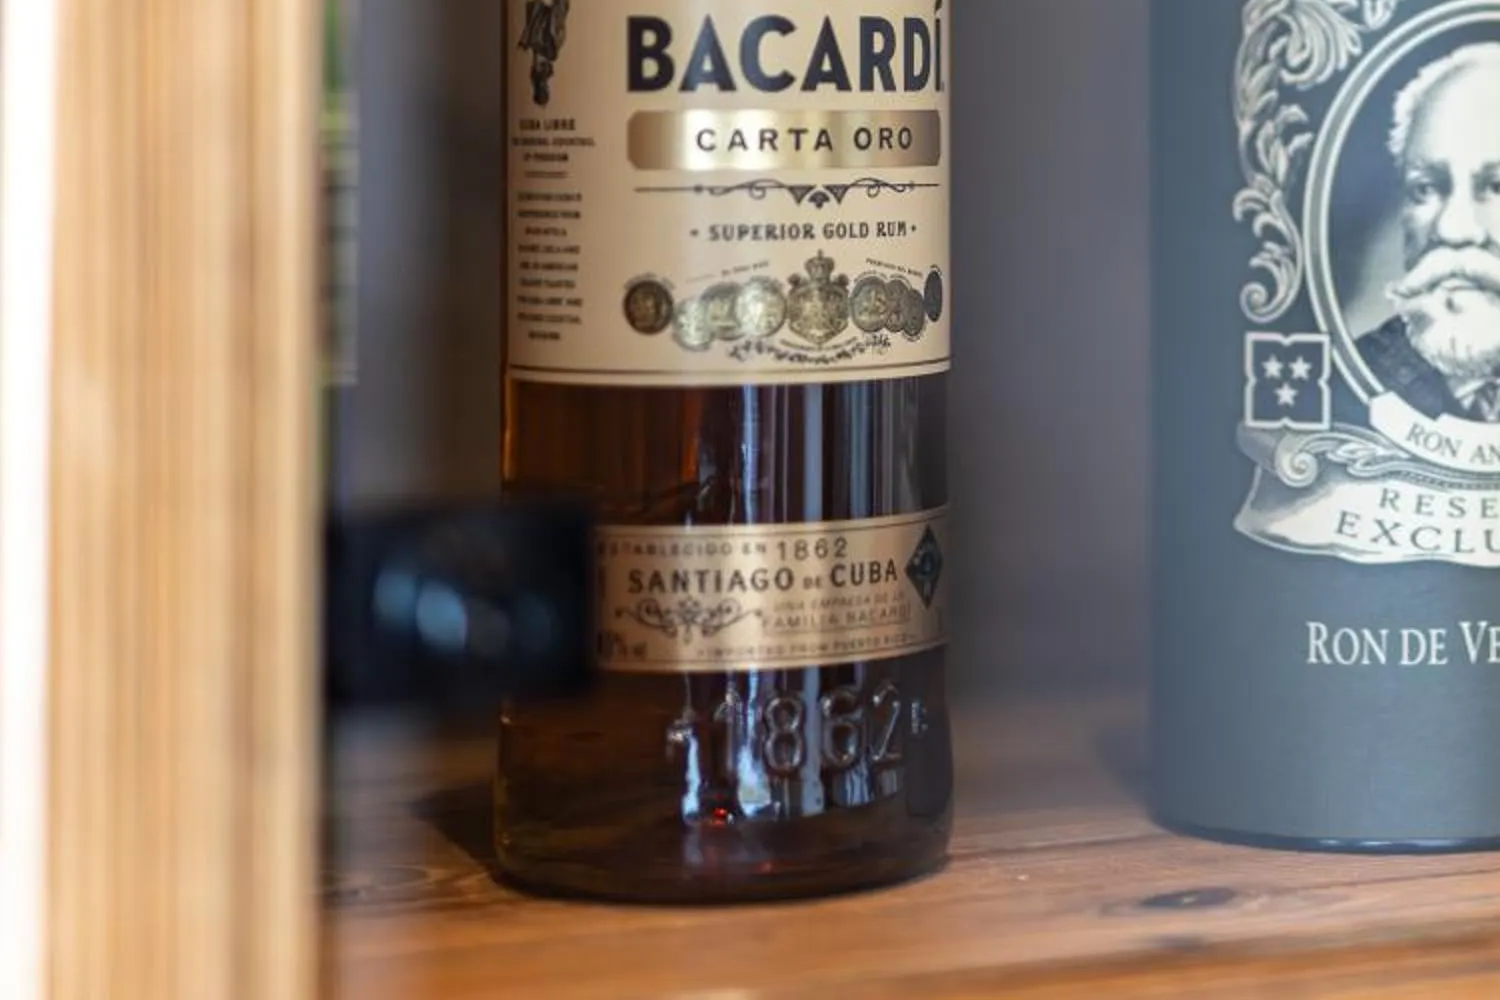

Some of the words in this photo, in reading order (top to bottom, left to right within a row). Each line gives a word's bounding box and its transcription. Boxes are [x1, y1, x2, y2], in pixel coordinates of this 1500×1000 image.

[696, 128, 834, 152] CARTA
[853, 126, 913, 150] ORO
[708, 222, 816, 242] SUPERIOR
[823, 221, 870, 240] GOLD
[876, 220, 907, 238] RUM
[1405, 421, 1463, 459] RON
[777, 535, 849, 562] 1862
[628, 567, 795, 594] SANTIAGO
[803, 576, 823, 590] DE
[831, 557, 899, 588] CUBA
[1306, 621, 1389, 665] RON
[1400, 627, 1448, 666] DE
